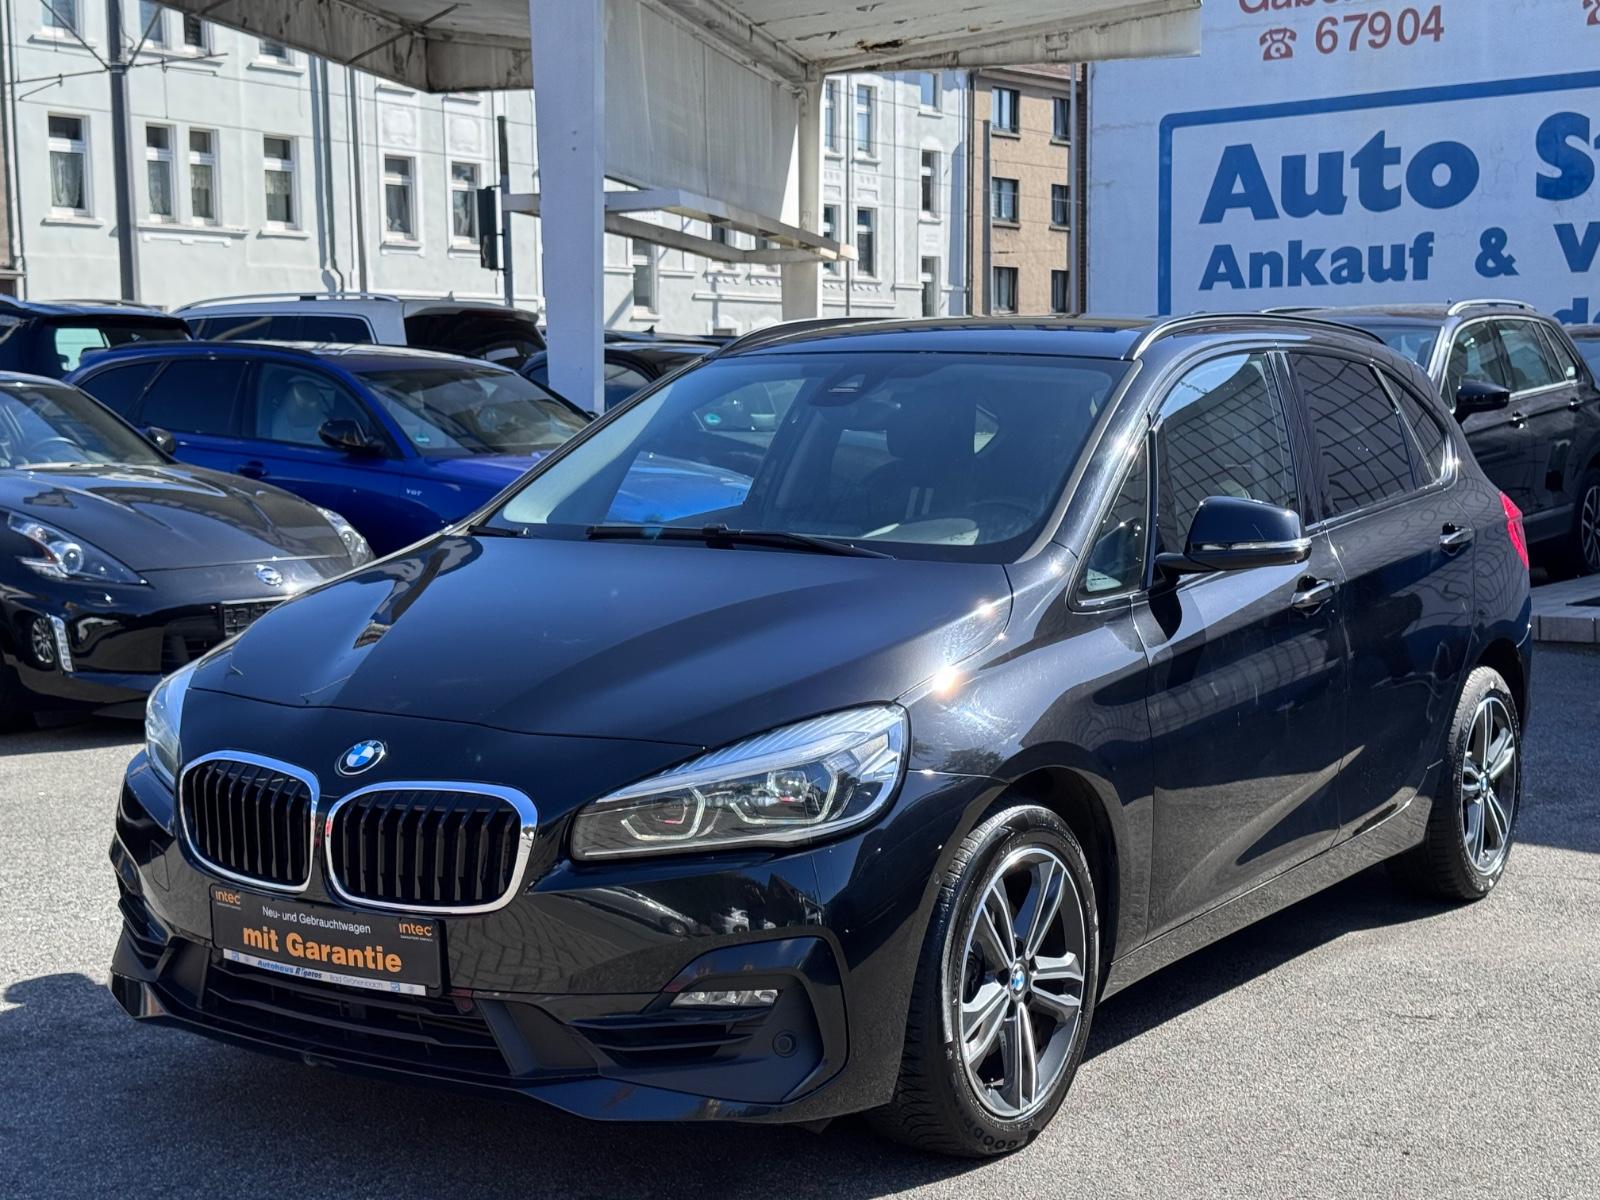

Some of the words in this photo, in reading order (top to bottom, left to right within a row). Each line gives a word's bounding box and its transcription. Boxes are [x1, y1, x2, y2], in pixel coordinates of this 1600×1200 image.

[1315, 6, 1445, 54] 67904
[1199, 130, 1480, 224] Auto
[1536, 111, 1600, 201] S
[1199, 231, 1434, 291] Ankauf
[1475, 227, 1519, 278] &
[215, 890, 241, 905] intec
[262, 905, 280, 919] Neu-
[283, 912, 297, 923] und
[299, 912, 371, 935] Gebrauchtwagen
[243, 926, 279, 953] mit
[286, 932, 402, 973] Garantie
[398, 922, 433, 936] intec
